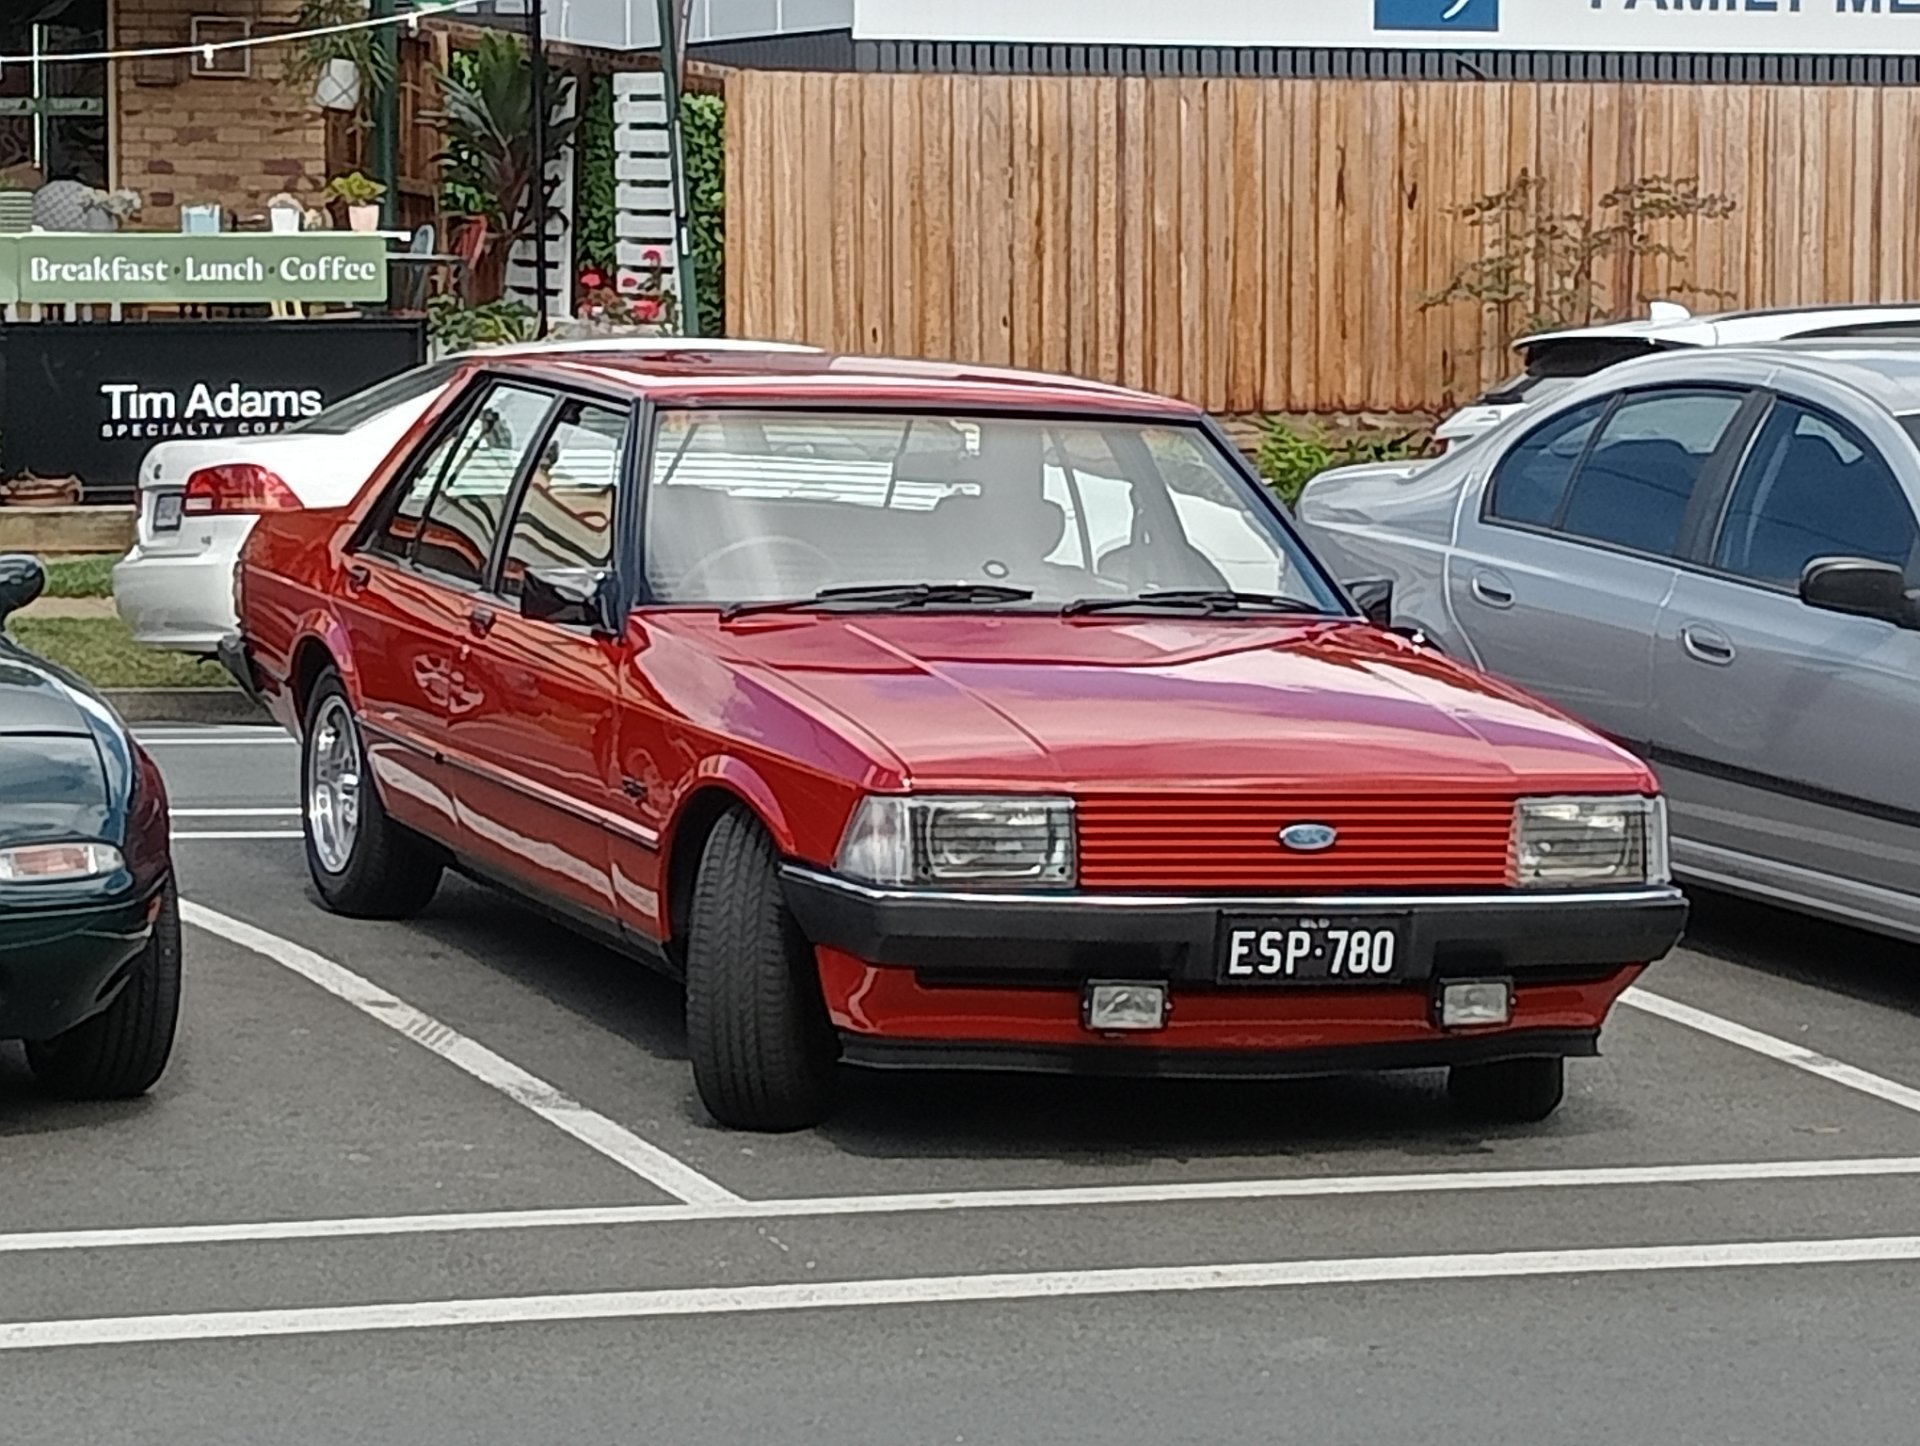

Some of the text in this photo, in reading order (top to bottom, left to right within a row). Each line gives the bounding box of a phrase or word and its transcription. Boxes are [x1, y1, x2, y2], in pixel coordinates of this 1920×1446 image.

[31, 256, 377, 282] Breakfast Lunch Coffee
[101, 382, 323, 420] Tim Adams
[102, 422, 224, 437] SPECIALTY
